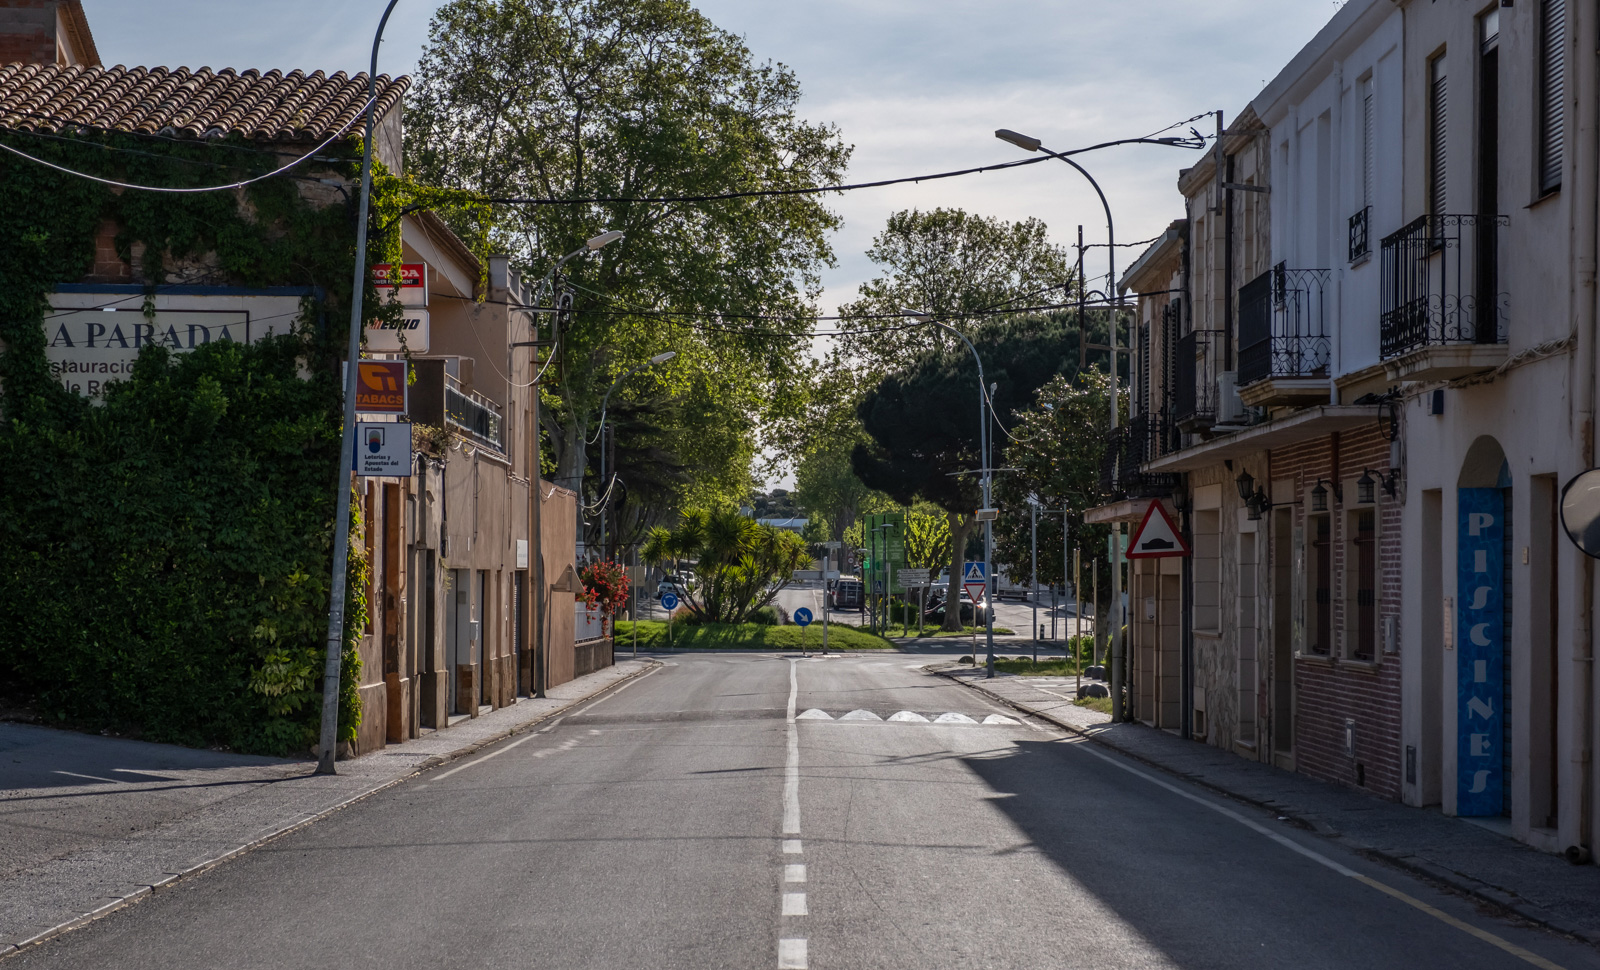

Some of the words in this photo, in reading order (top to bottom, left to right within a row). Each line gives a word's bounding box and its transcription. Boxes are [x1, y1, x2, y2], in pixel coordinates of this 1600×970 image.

[372, 269, 420, 277] ODA
[85, 323, 233, 349] PARADA
[357, 394, 403, 404] TABACS
[1466, 512, 1495, 794] PISCINES
